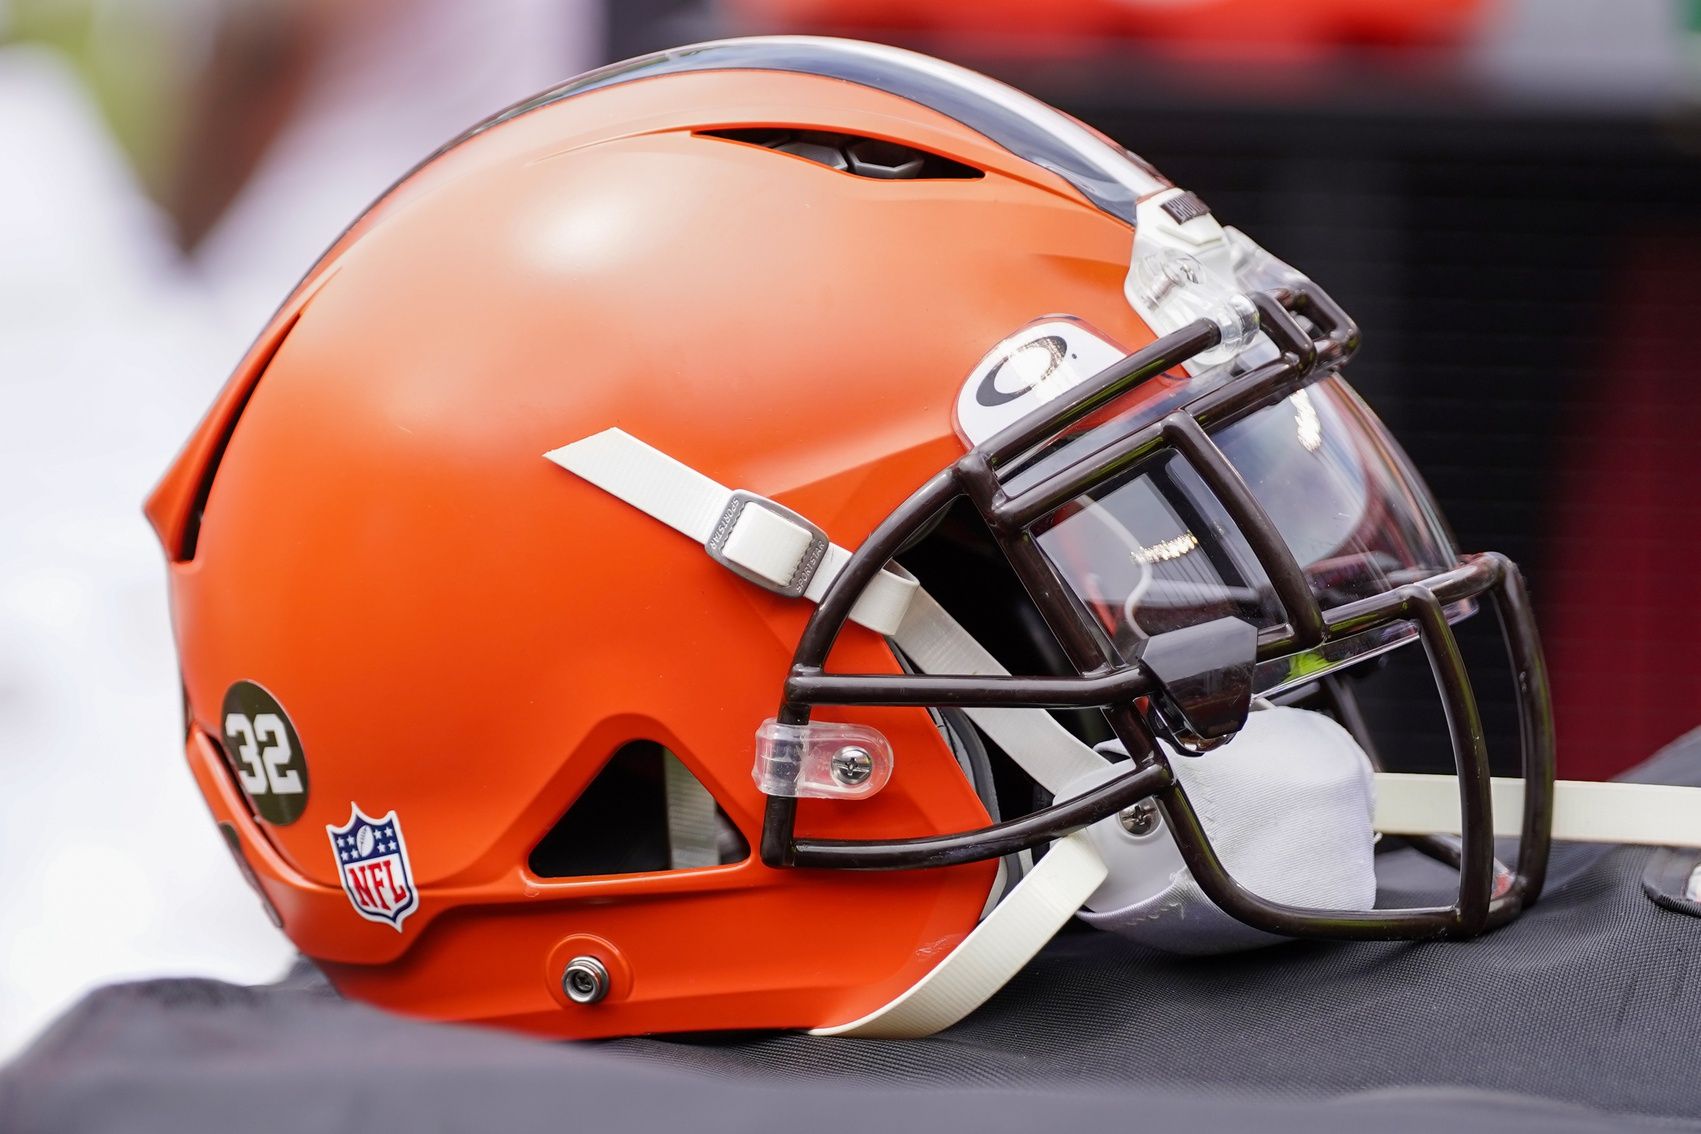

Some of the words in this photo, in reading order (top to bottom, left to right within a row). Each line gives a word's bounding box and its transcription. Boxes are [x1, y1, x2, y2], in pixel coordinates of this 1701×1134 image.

[709, 497, 740, 550] SPORTSTAR
[796, 540, 825, 593] SPORTSTAR
[225, 713, 303, 795] 32
[349, 860, 407, 911] NFL
